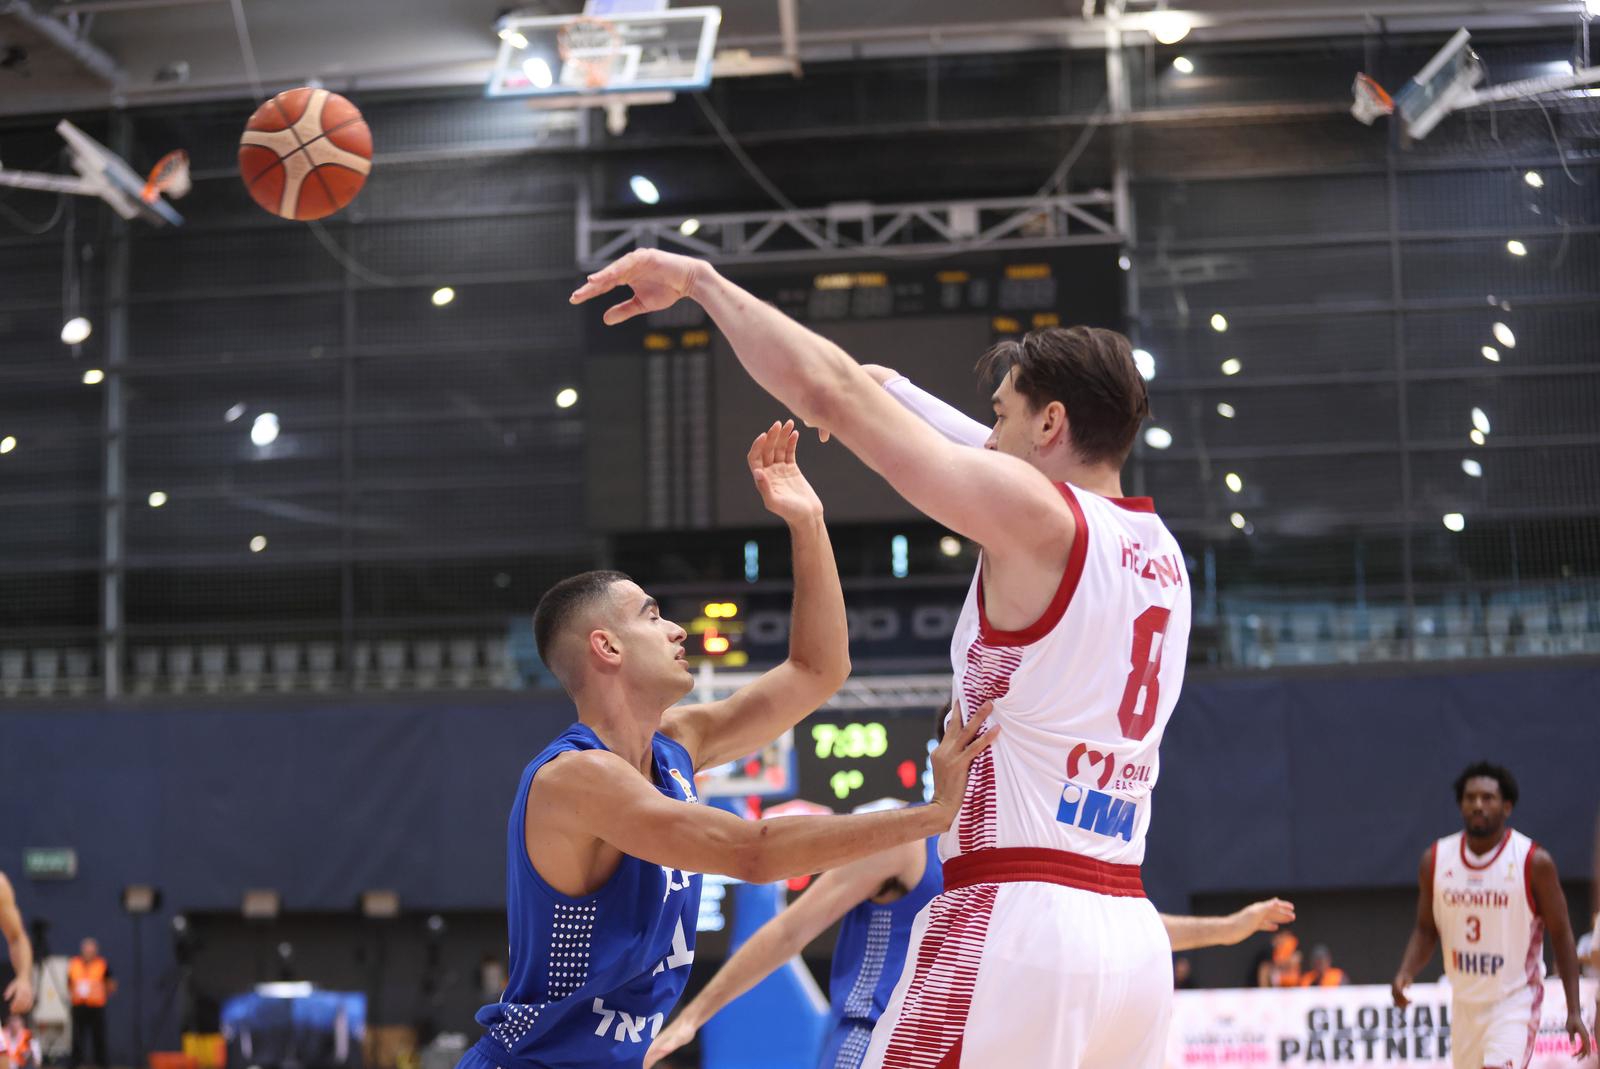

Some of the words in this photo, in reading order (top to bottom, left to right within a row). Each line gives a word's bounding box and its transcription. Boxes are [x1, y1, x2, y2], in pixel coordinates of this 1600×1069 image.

[1117, 605, 1171, 741] 8
[1443, 888, 1509, 909] CROATIA
[1466, 915, 1481, 944] 3
[1307, 1004, 1452, 1033] GLOBAL
